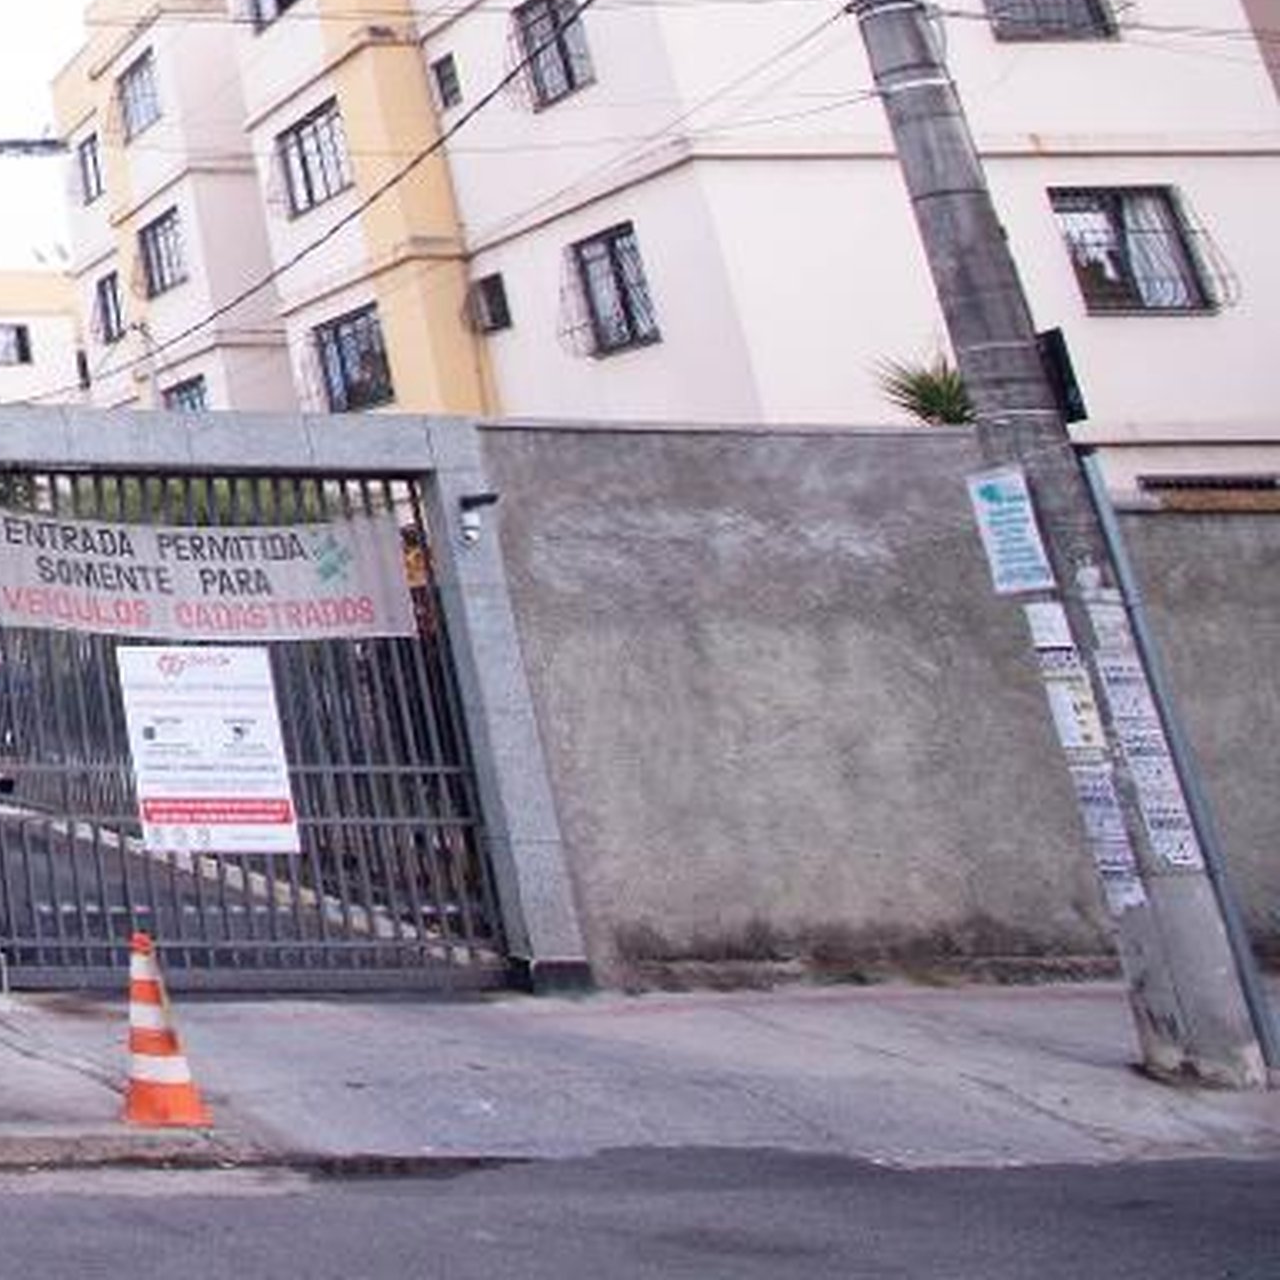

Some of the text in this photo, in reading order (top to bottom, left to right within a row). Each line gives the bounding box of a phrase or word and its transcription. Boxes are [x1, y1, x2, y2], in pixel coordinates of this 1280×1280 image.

[3, 516, 309, 563] ENTRADA PERMITIDA
[36, 554, 273, 596] SOMENTE PARA
[174, 595, 374, 631] CADASTRADOS
